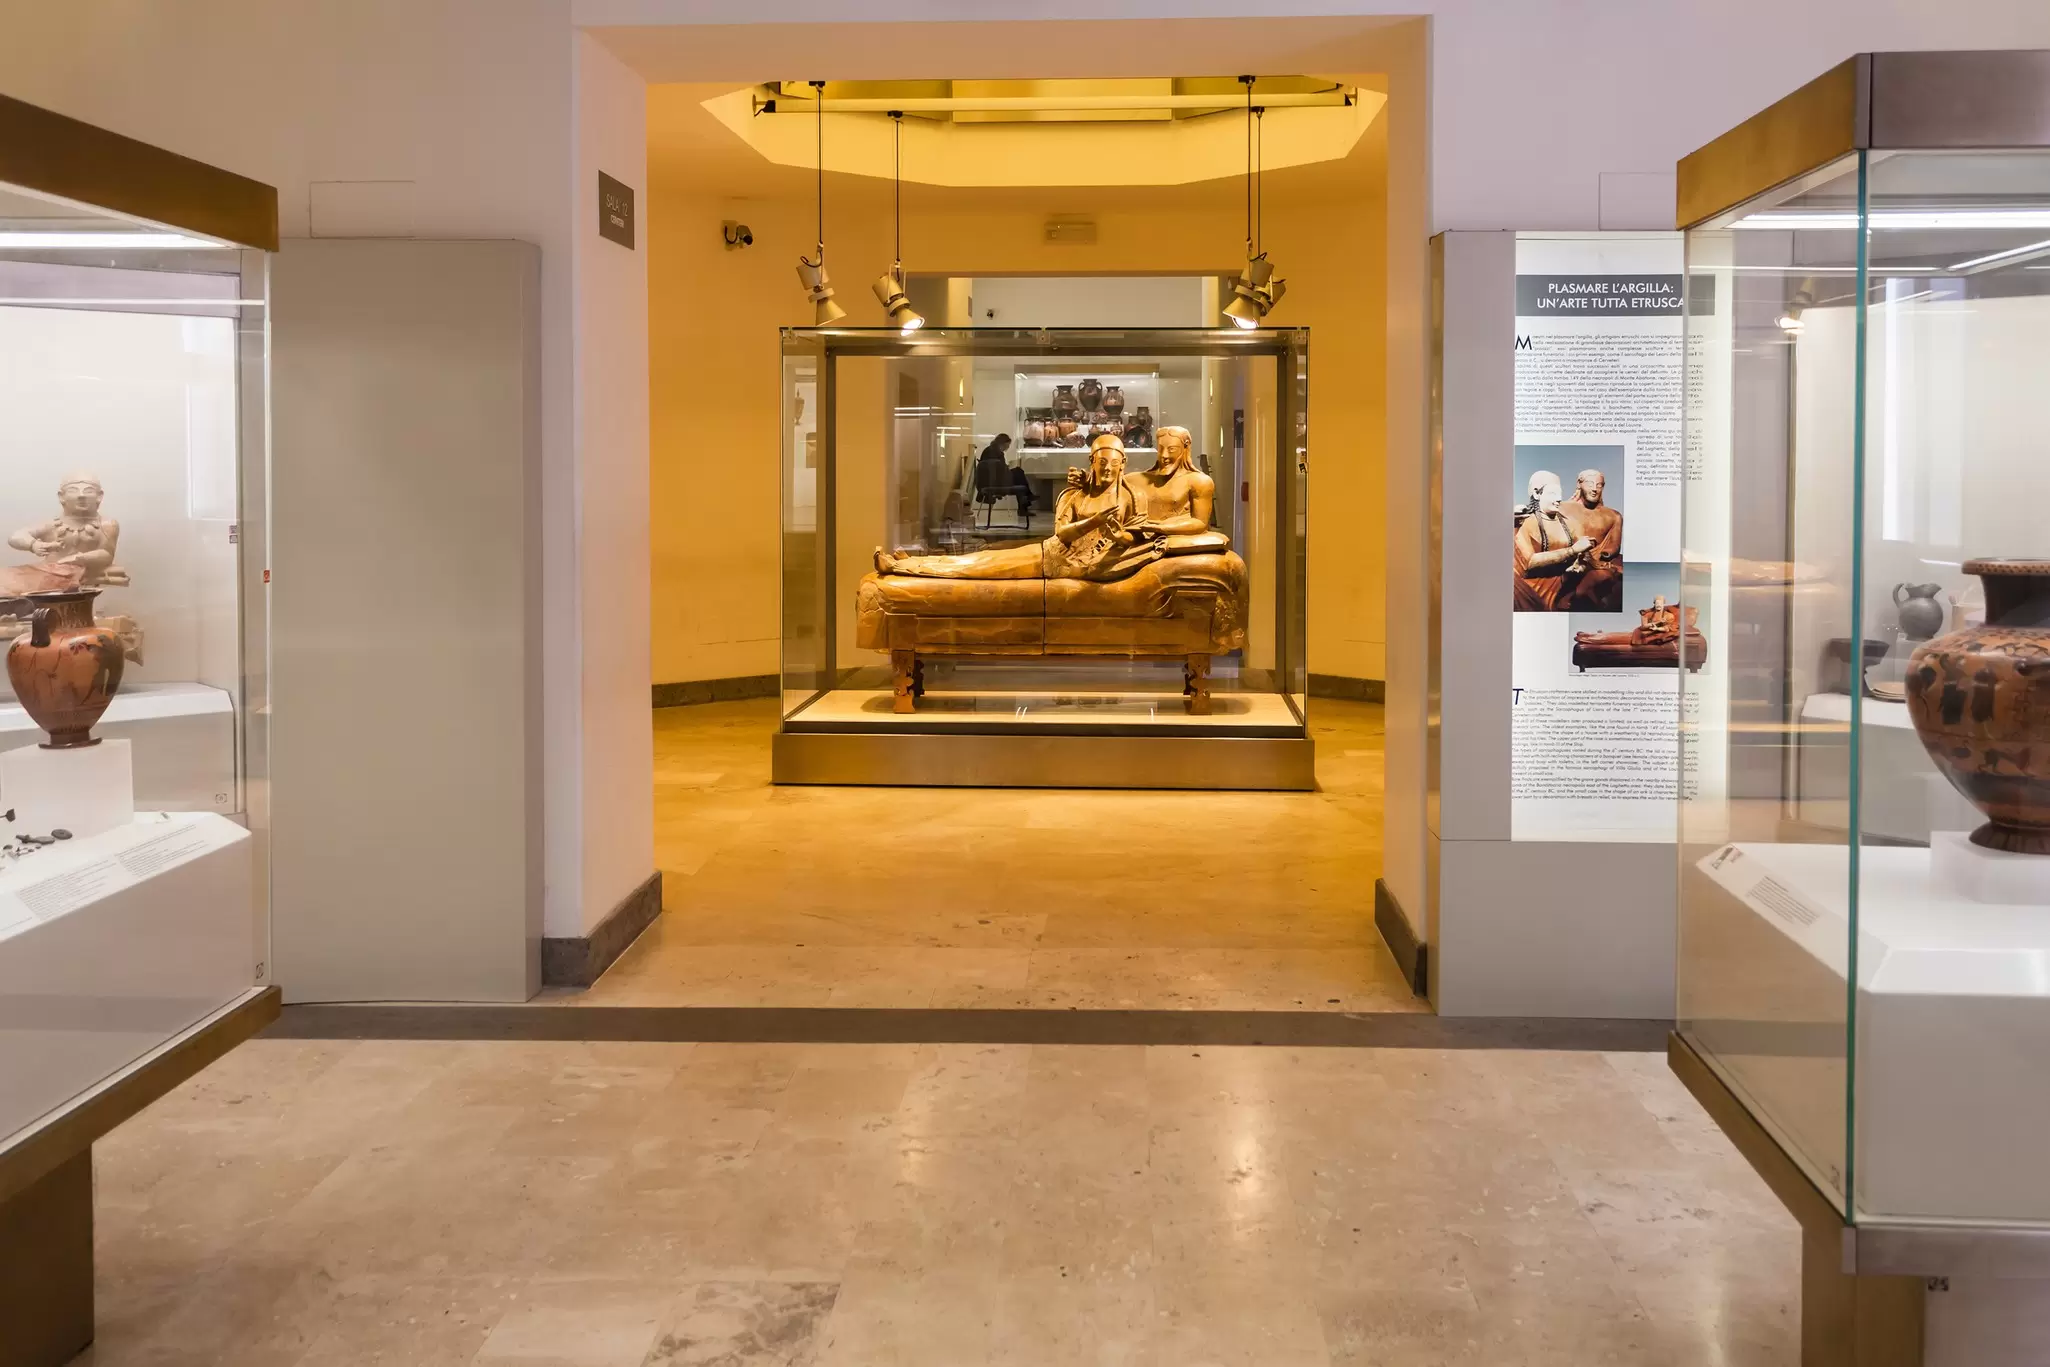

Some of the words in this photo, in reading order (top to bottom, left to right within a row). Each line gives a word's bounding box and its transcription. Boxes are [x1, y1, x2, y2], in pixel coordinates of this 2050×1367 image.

[606, 193, 620, 213] SALA
[622, 202, 629, 217] 12
[1548, 283, 1609, 294] PLASMARE
[1612, 283, 1674, 294] L’ARGILLA:
[1537, 298, 1588, 309] UN’ARTE
[1591, 298, 1628, 309] TUTTA
[1631, 298, 1684, 309] ETRUSCA
